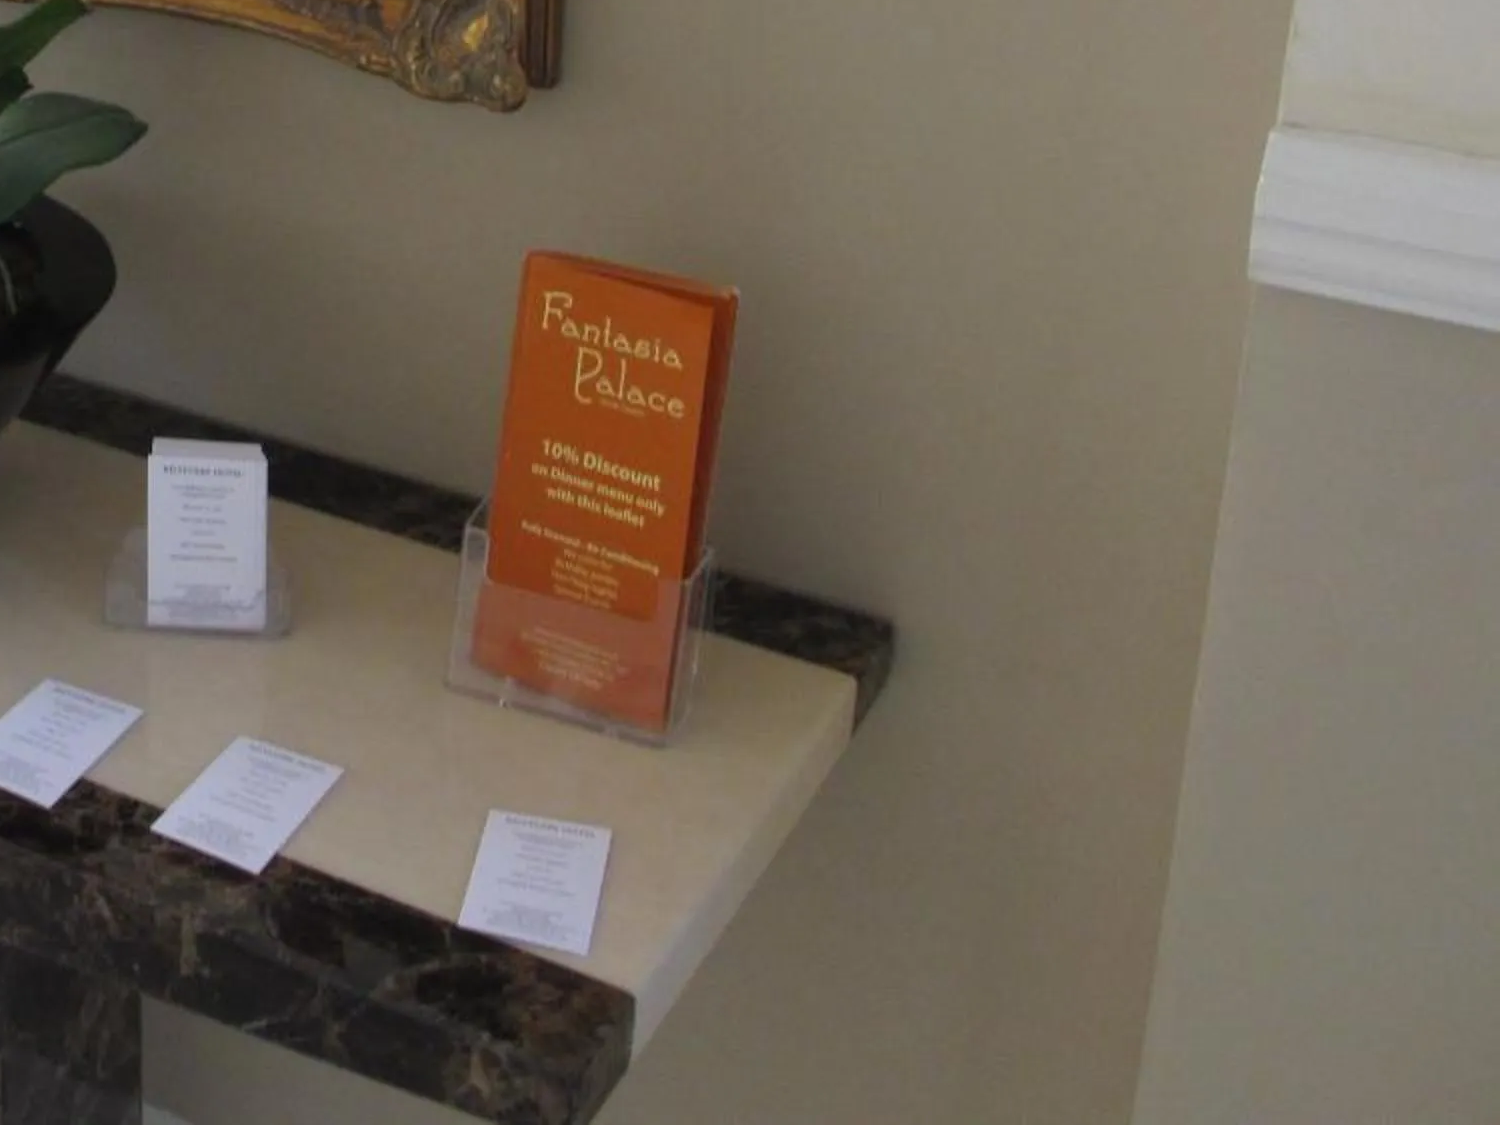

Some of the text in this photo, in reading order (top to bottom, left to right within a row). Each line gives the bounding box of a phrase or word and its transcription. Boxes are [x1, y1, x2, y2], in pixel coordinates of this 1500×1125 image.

[541, 291, 683, 371] Fantasia
[574, 347, 686, 419] Palace
[542, 438, 661, 491] 10% Discount
[577, 494, 602, 513] this
